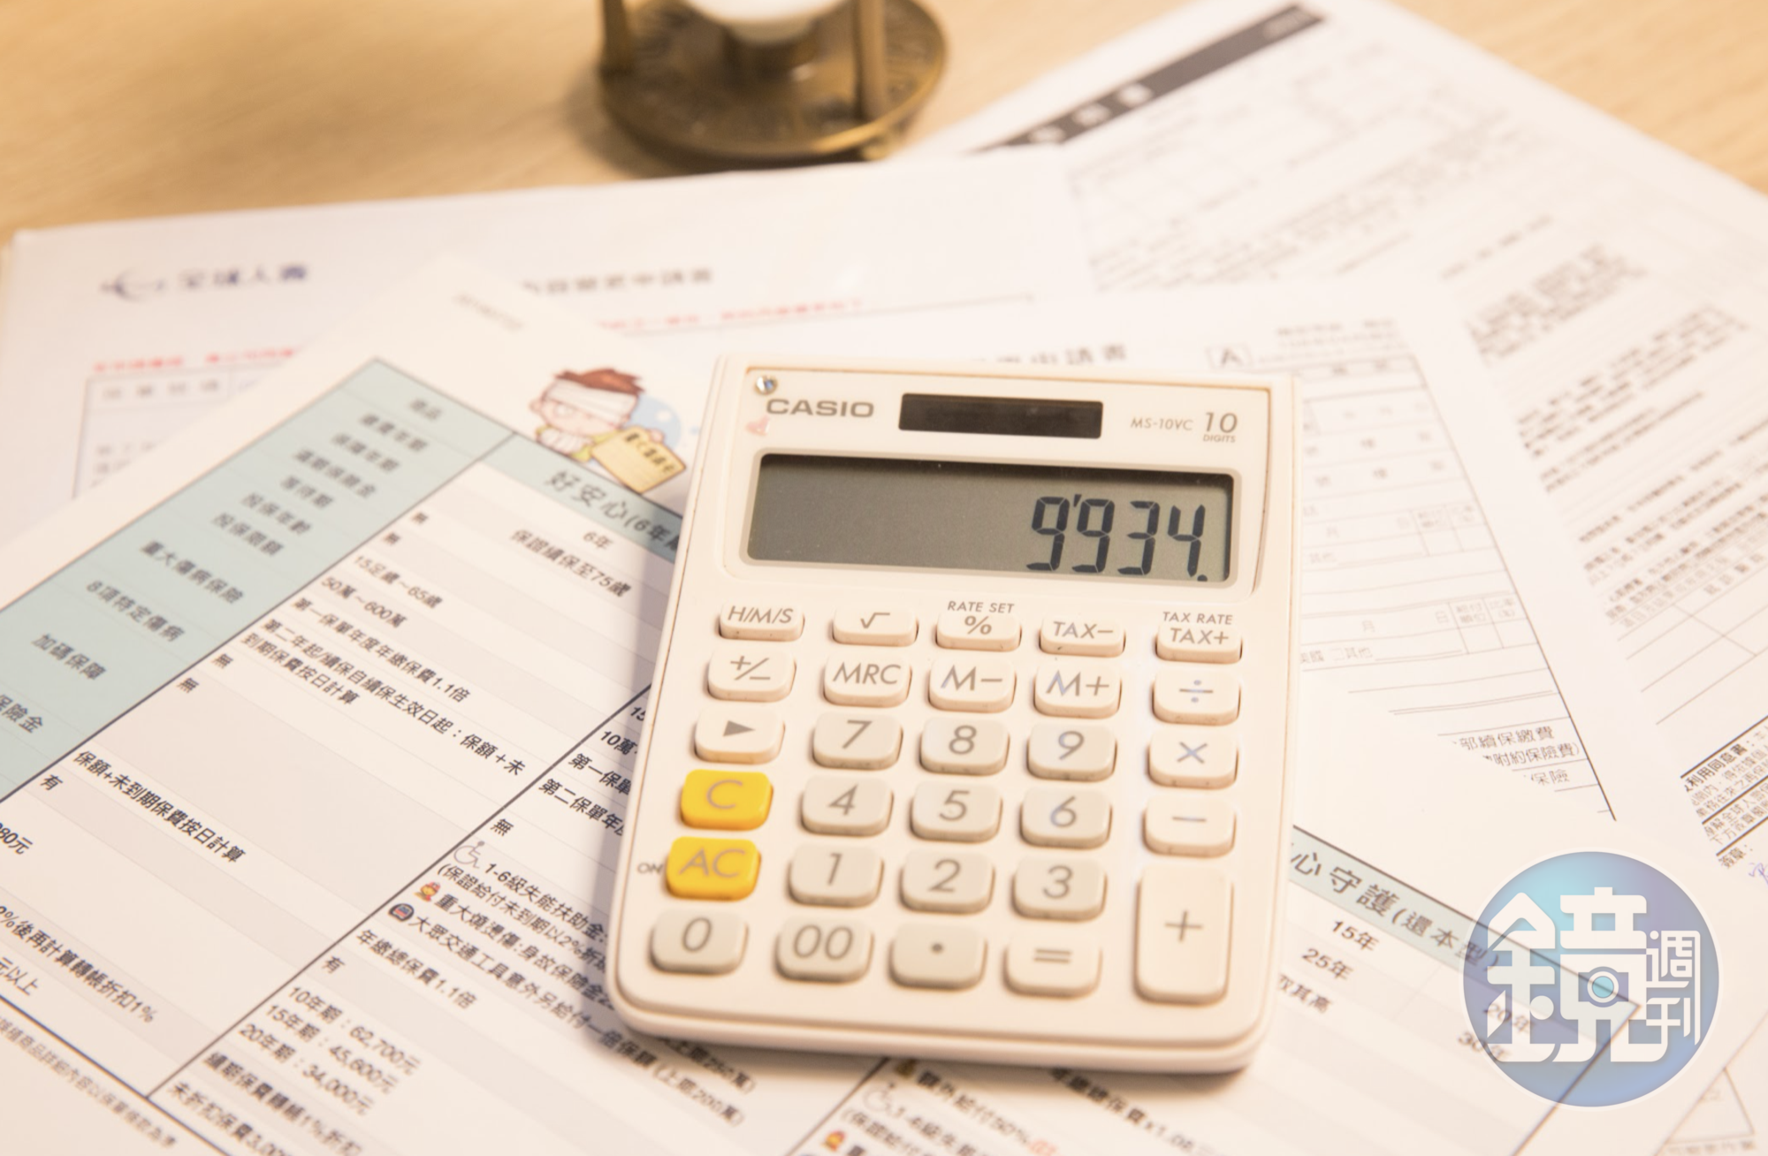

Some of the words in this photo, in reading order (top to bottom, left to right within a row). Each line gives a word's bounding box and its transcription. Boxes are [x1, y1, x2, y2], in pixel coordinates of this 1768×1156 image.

[766, 398, 875, 419] CASIO
[1130, 414, 1194, 432] MS-10VC
[1203, 411, 1239, 434] 10
[1202, 433, 1237, 444] DIGITS
[727, 604, 793, 626] H/M/S
[947, 601, 985, 614] RATE
[989, 602, 1015, 615] SET
[1162, 611, 1188, 624] TAX
[1191, 613, 1234, 625] RATE
[964, 615, 993, 636] %
[1169, 626, 1230, 647] TAX+
[212, 653, 233, 669] 無
[240, 632, 359, 705] 到期保費按日計算
[832, 663, 902, 686] MRC
[177, 677, 199, 693] 無
[1046, 671, 1110, 697] M+
[842, 719, 872, 749] 7
[947, 724, 978, 755] 8
[1057, 730, 1085, 761] 9
[40, 773, 64, 791] 有
[706, 779, 744, 809] C
[73, 751, 246, 863] 保額+未到期保費按日計算
[829, 784, 857, 816] 4
[939, 789, 968, 822] 5
[1050, 795, 1078, 828] 6
[490, 818, 514, 837] 無
[637, 862, 665, 875] ON
[678, 847, 748, 878] AC
[826, 853, 844, 886] 1
[932, 859, 962, 892] 2
[1043, 865, 1072, 899] 3
[681, 917, 713, 953] 0
[793, 924, 856, 962] 00
[1331, 919, 1380, 952] 15年
[321, 955, 345, 974] 有
[1302, 948, 1354, 982] 25年
